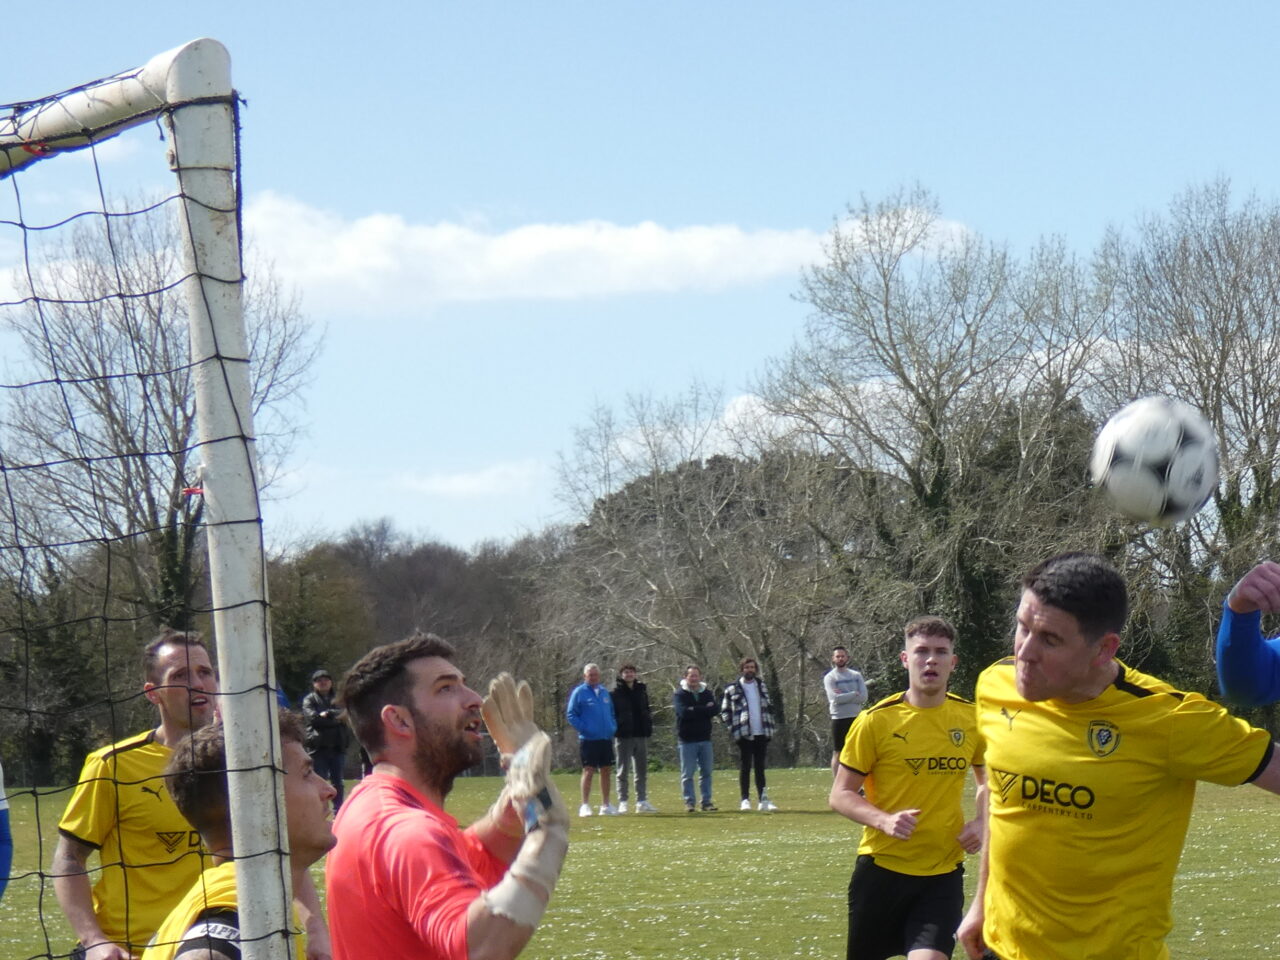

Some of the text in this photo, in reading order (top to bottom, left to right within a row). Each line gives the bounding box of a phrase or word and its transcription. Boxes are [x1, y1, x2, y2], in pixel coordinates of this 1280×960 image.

[928, 756, 967, 770] DECO
[1021, 775, 1096, 810] DECO
[200, 925, 241, 941] CAPT
